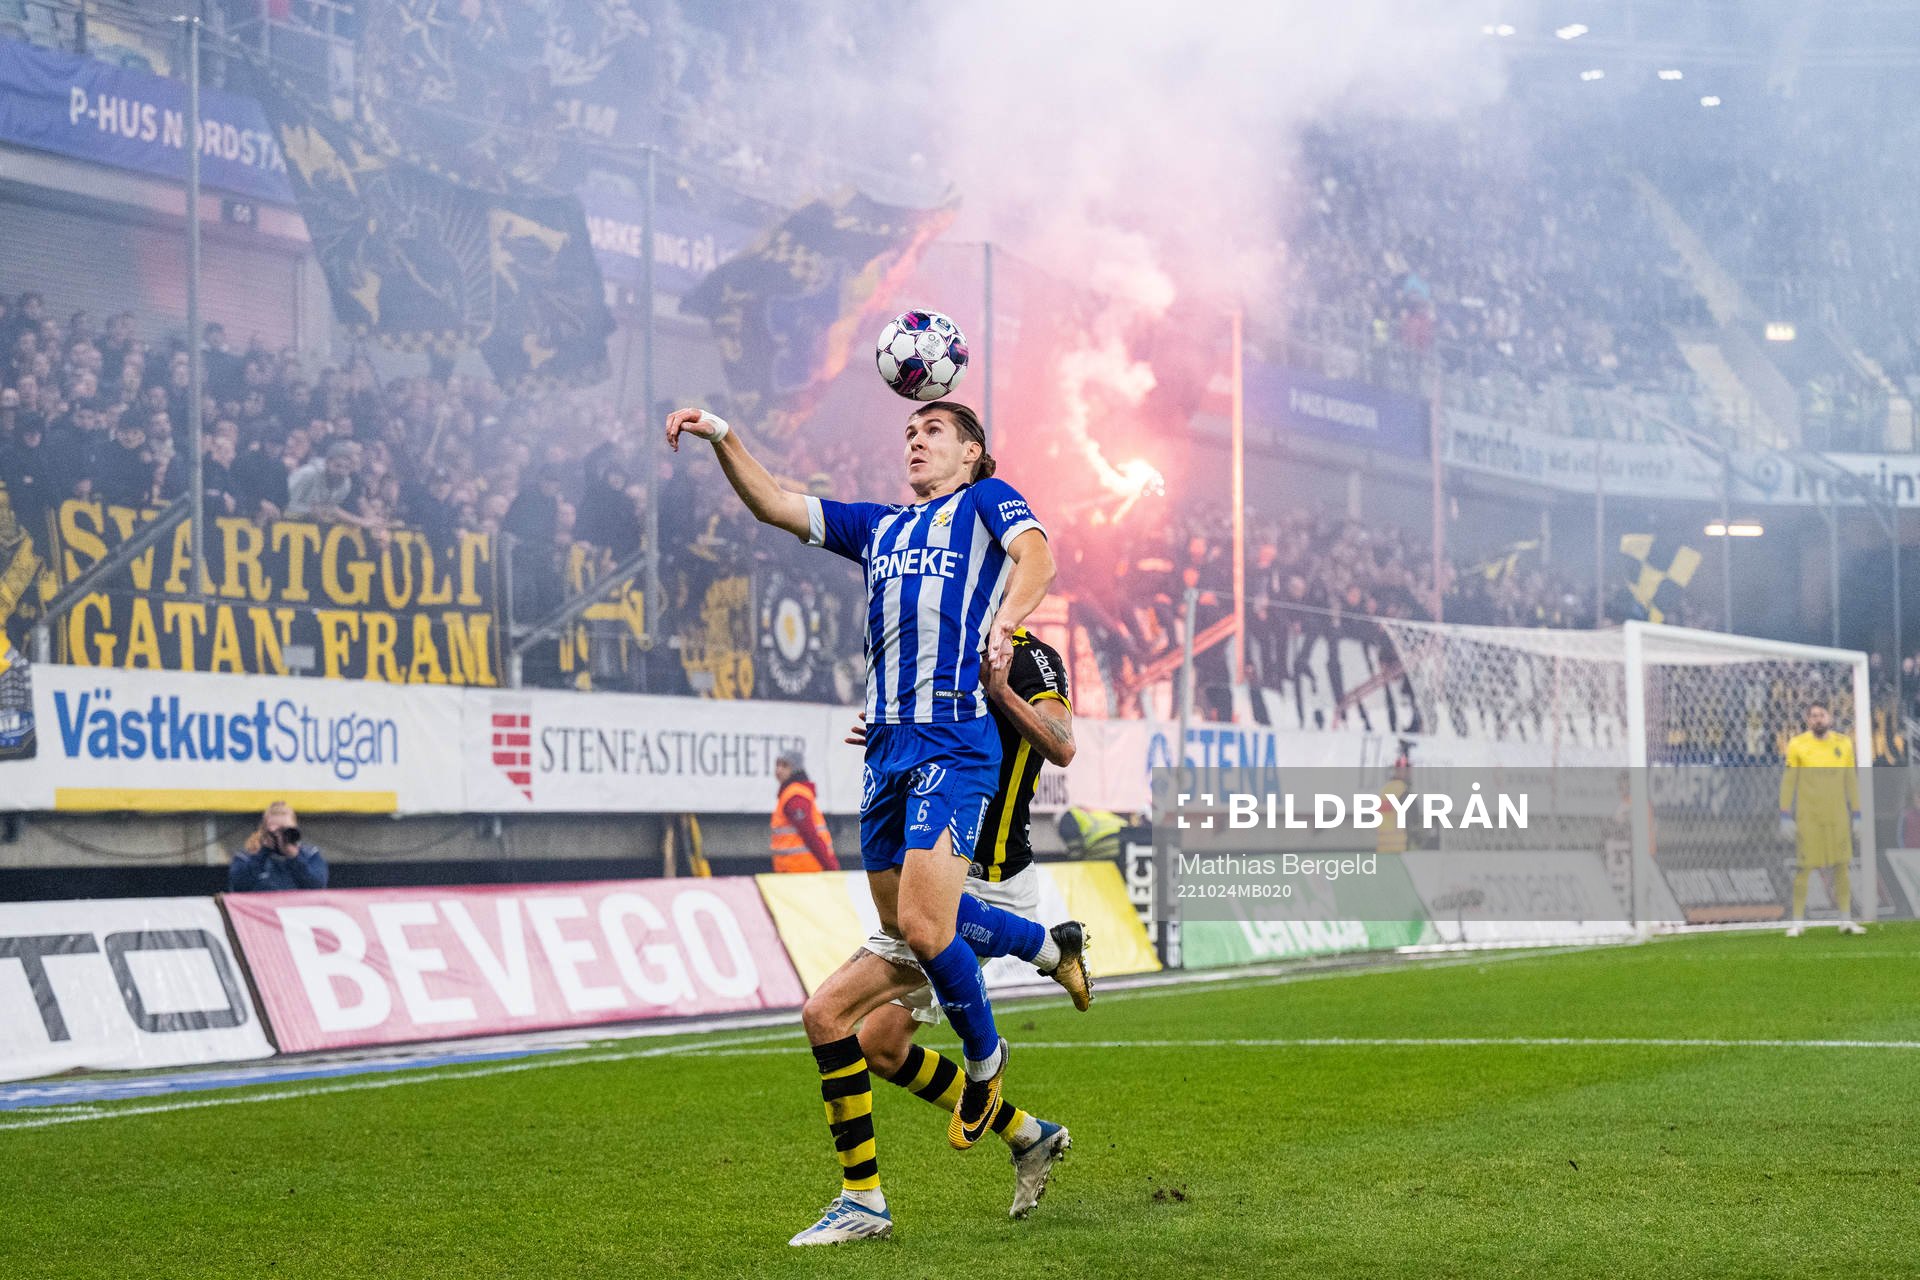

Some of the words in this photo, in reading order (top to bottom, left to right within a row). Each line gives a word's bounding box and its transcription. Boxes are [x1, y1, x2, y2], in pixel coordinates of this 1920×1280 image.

[69, 86, 158, 142] P-HUS
[998, 499, 1030, 512] mor
[1001, 508, 1029, 523] low
[60, 500, 491, 608] SVARTGULT
[69, 592, 296, 676] GATAN
[318, 611, 498, 687] FRAM
[54, 689, 398, 780] VästkustStugan
[1183, 729, 1283, 805] STENA
[917, 800, 931, 823] 6
[1034, 774, 1069, 804] HUS
[0, 929, 248, 1042] TO
[276, 890, 760, 1033] BEVEGO
